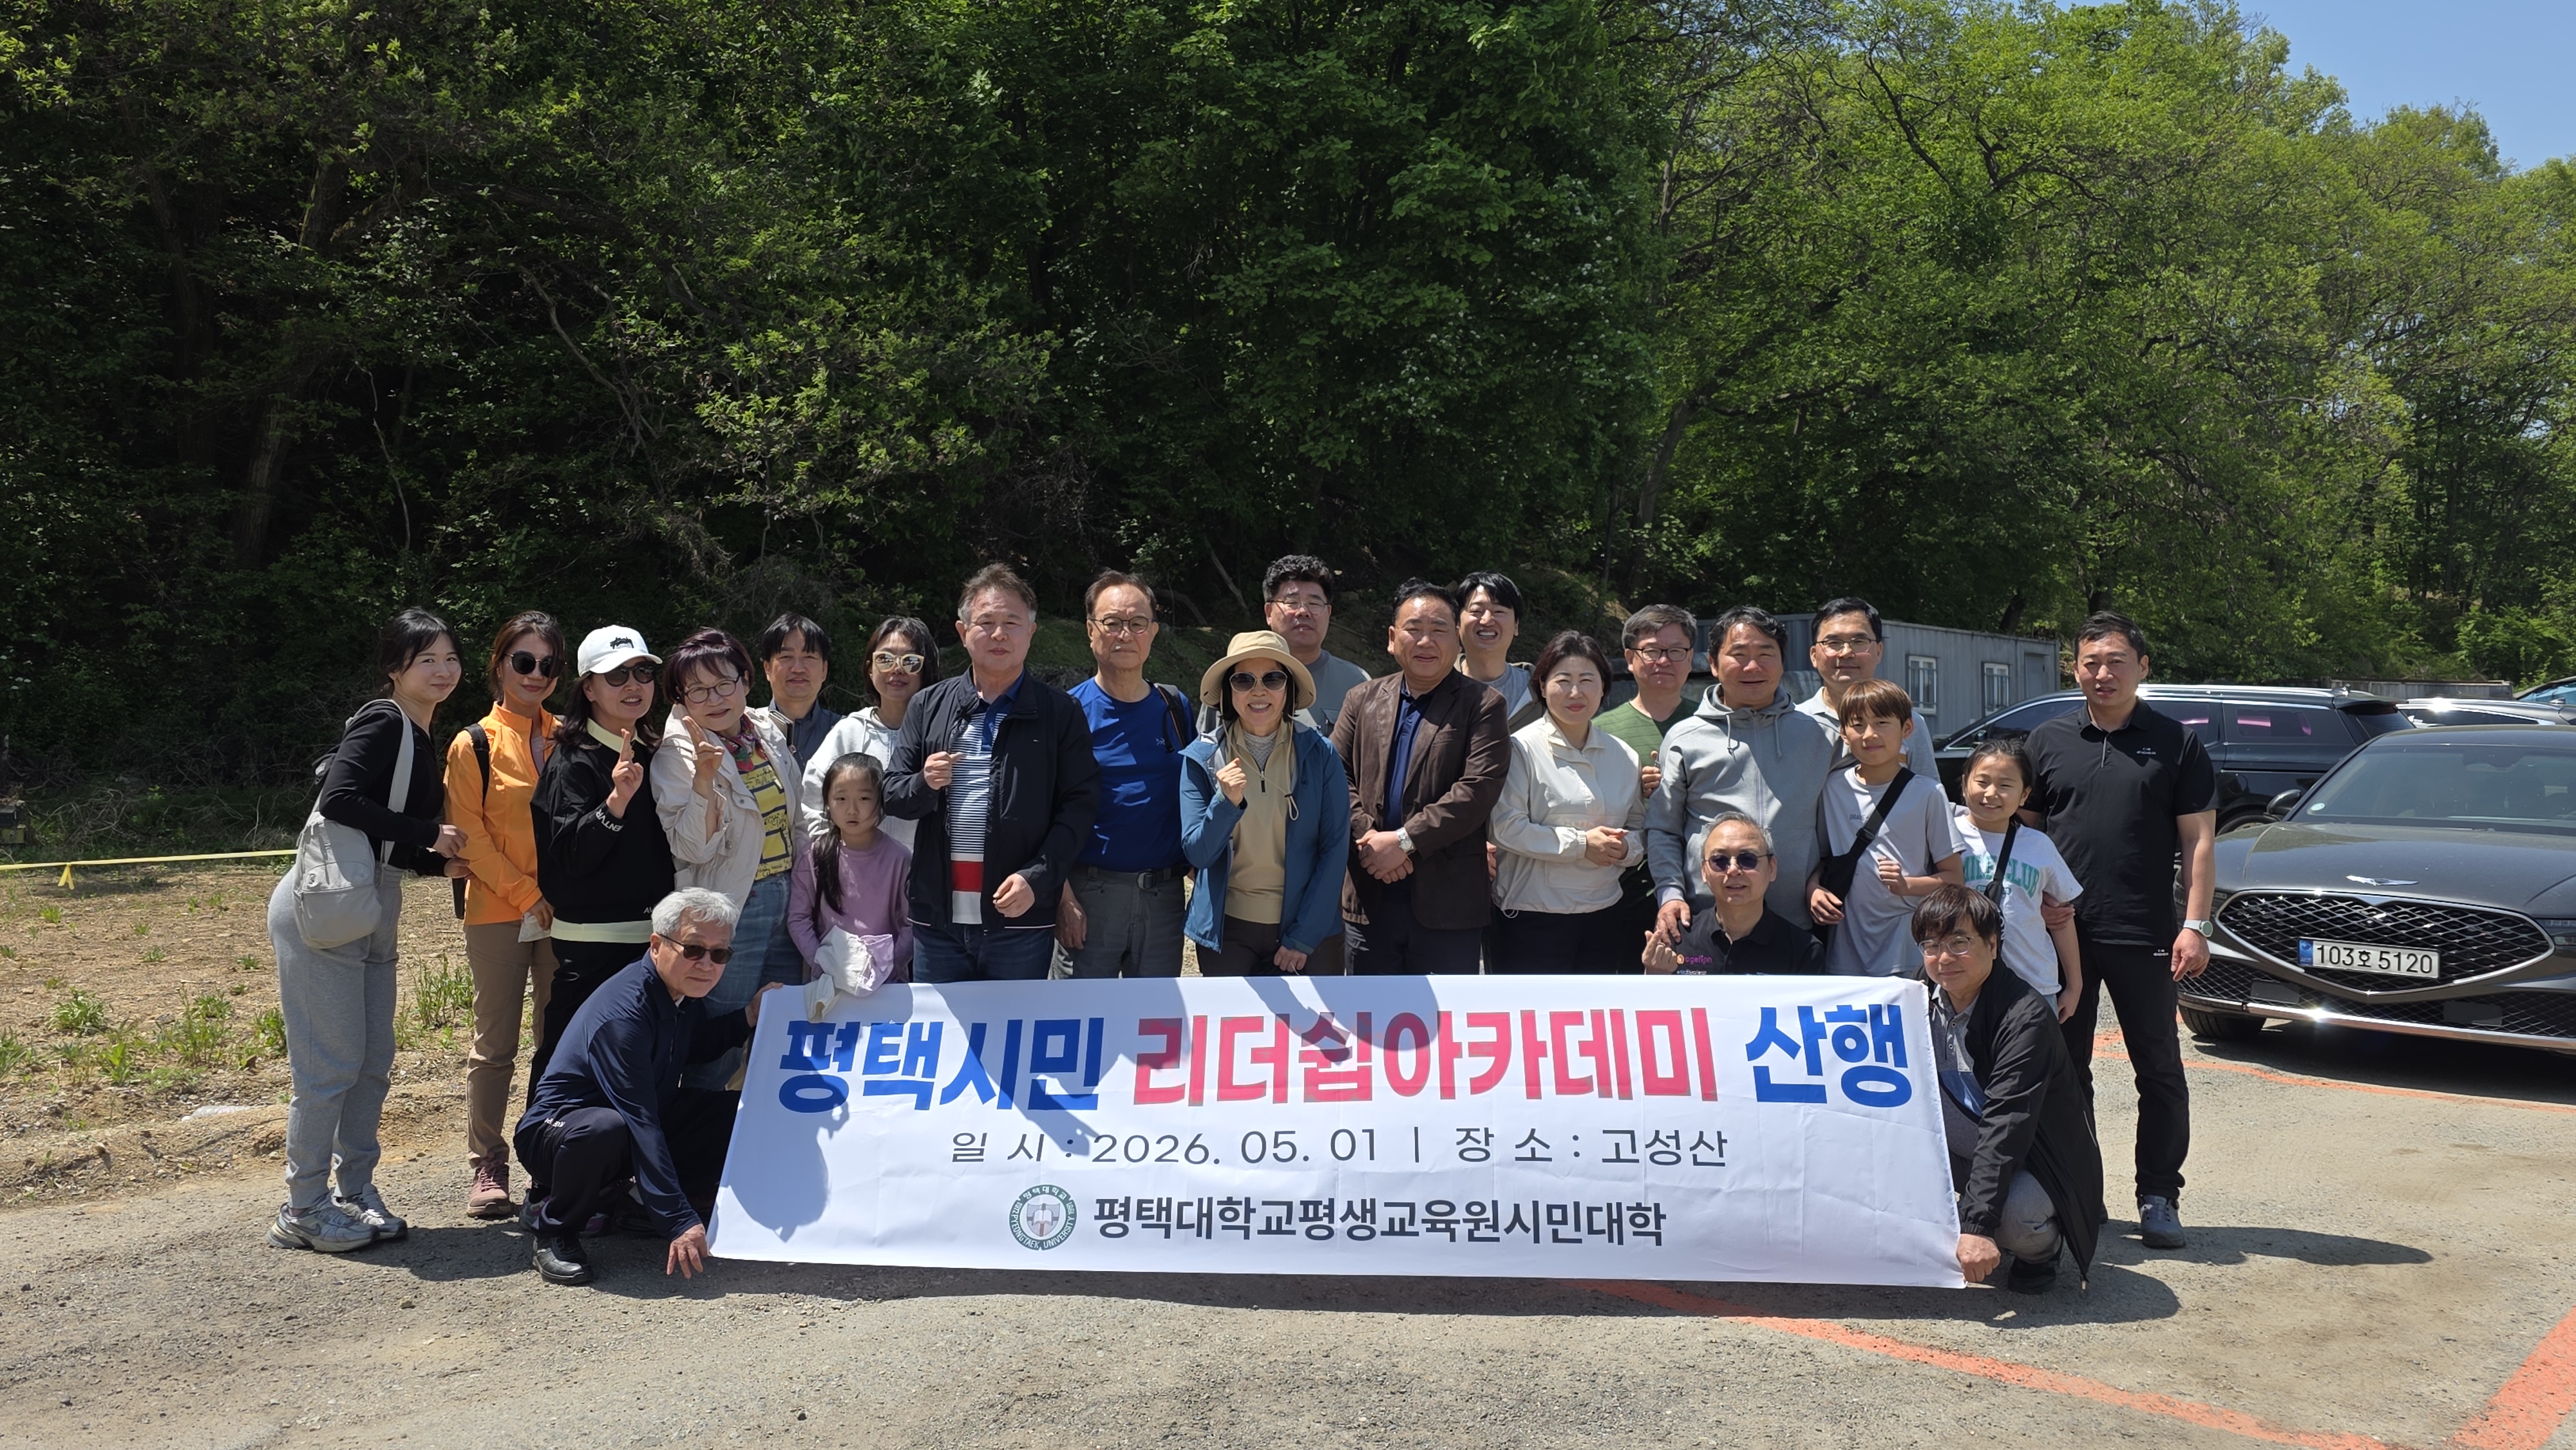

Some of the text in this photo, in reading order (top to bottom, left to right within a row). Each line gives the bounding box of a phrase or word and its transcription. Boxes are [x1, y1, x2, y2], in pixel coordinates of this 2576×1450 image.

[2316, 944, 2433, 974] 103호 5120
[779, 1004, 1913, 1113] 평택시민 리더쉽아카데미 산행
[952, 1133, 987, 1162] 일
[1007, 1134, 1045, 1162] 시
[1092, 1134, 1220, 1164] 2026.
[1240, 1131, 1309, 1163] 05.
[1331, 1129, 1376, 1161] 01
[1456, 1127, 1495, 1162] 장
[1515, 1128, 1553, 1162] 소
[1602, 1129, 1728, 1167] 고성산
[1010, 1214, 1040, 1248] PYEONGTAEK
[1043, 1216, 1075, 1248] UNIVERSITY
[1094, 1196, 1667, 1247] 평택대학교평생교육원시민대학
